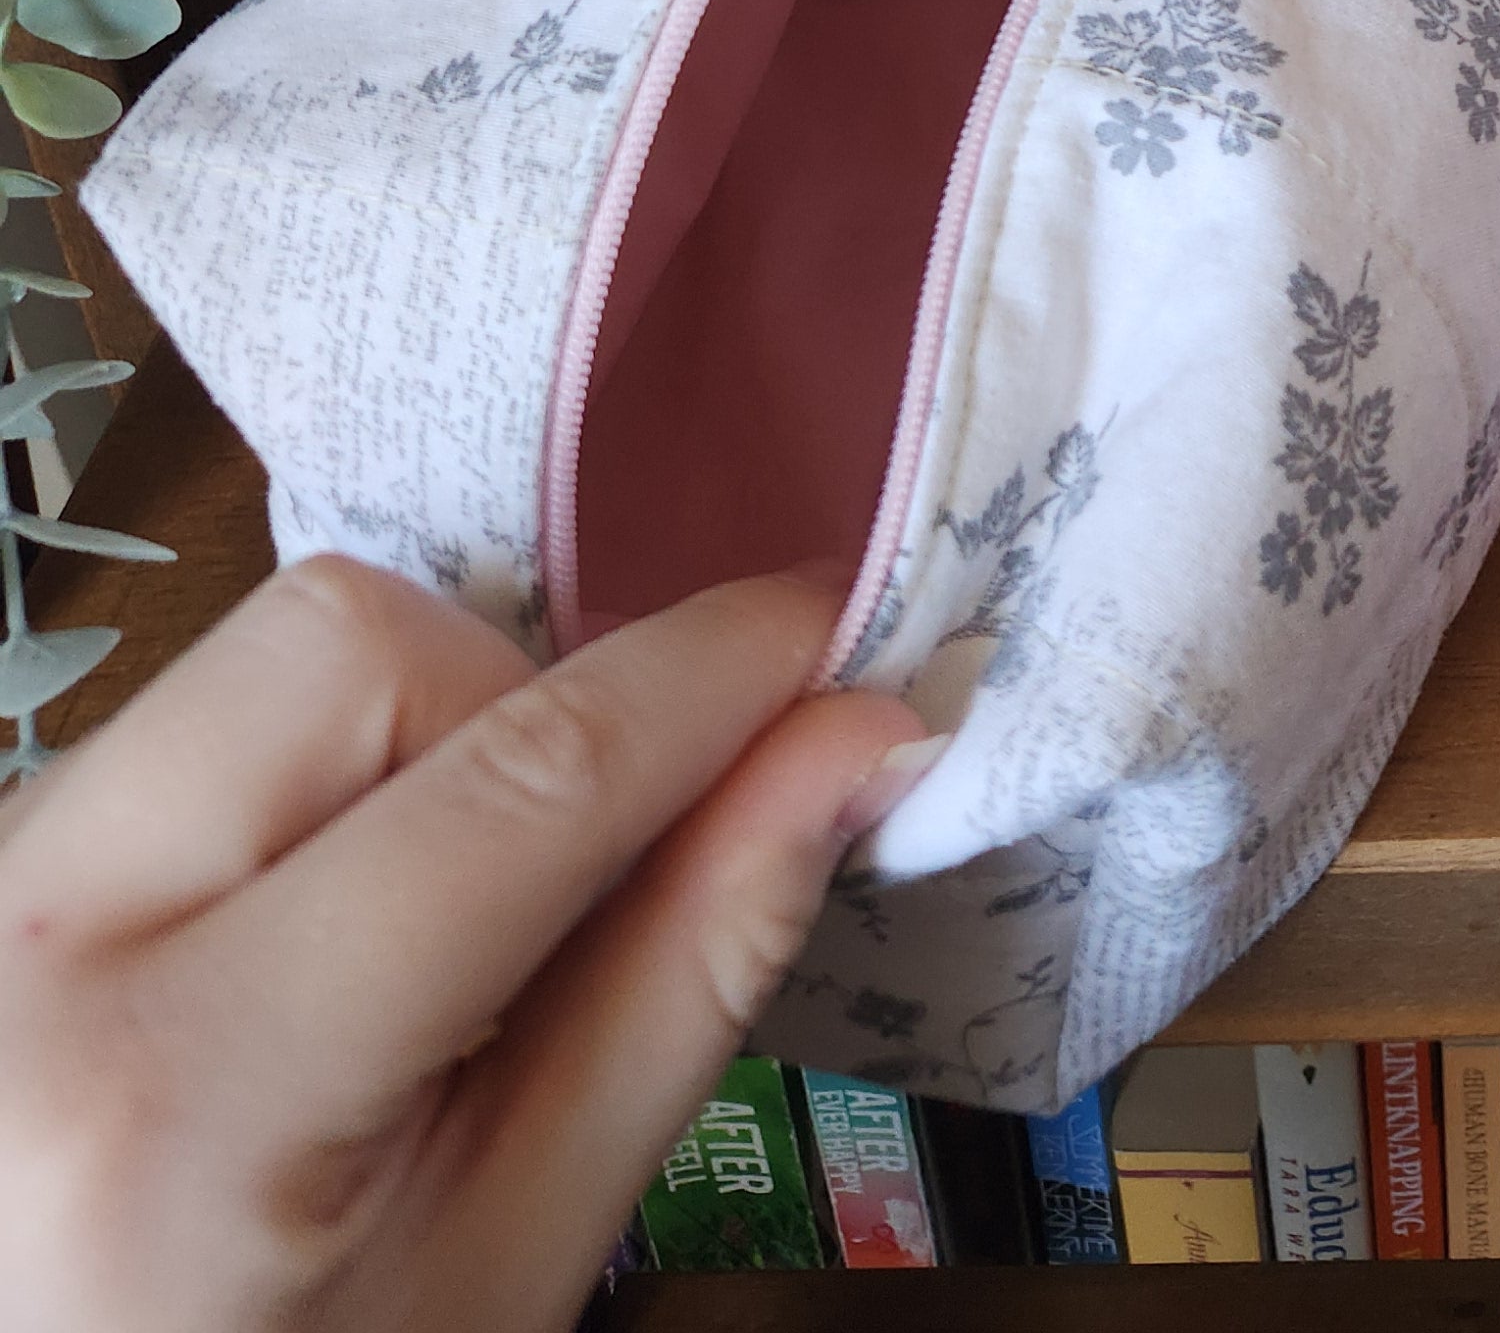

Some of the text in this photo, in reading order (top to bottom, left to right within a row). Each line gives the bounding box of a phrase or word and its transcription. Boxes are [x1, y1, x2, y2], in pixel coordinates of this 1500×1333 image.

[700, 1099, 776, 1196] AFTER
[812, 1089, 864, 1196] EVER HAPPY
[843, 1088, 911, 1174] AFTER
[1382, 1040, 1427, 1237] LINTKNAPPING
[1278, 1156, 1303, 1214] TARA
